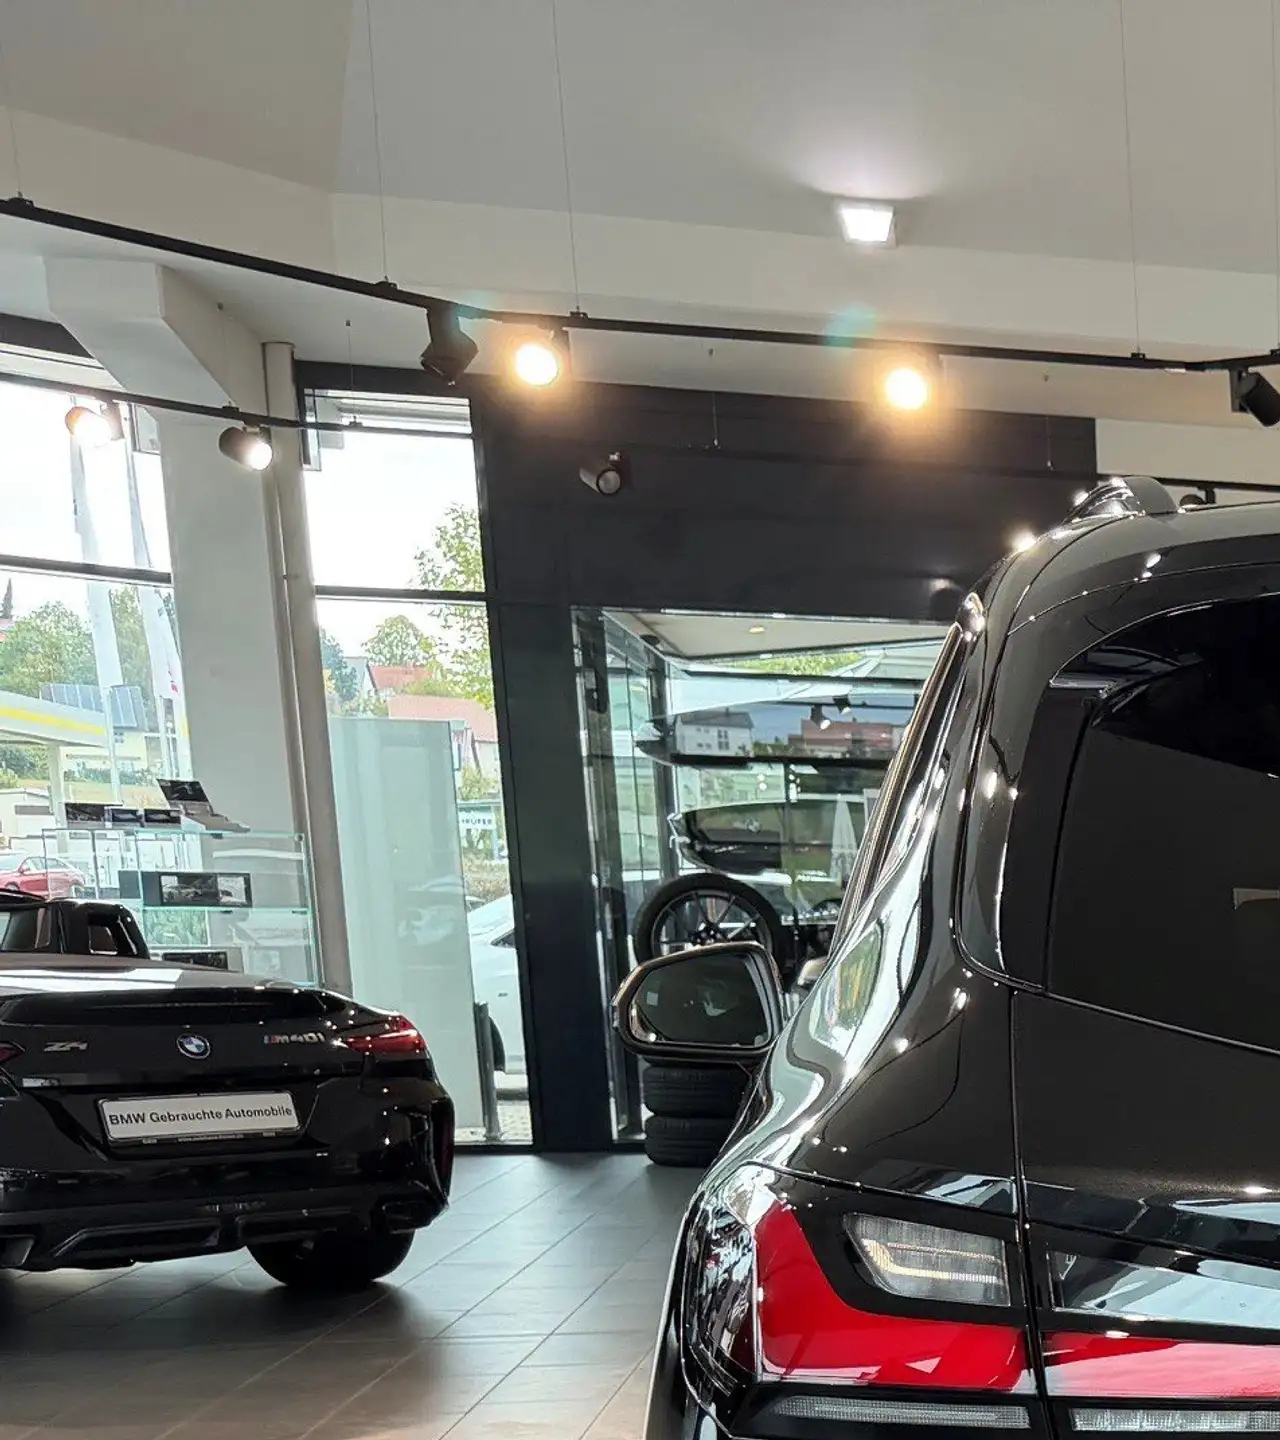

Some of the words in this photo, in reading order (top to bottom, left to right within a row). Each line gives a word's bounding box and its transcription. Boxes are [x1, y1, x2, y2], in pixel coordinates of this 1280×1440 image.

[108, 1113, 146, 1126] BMW
[149, 1109, 223, 1123] Gebrauchte
[225, 1105, 293, 1119] Automobile
